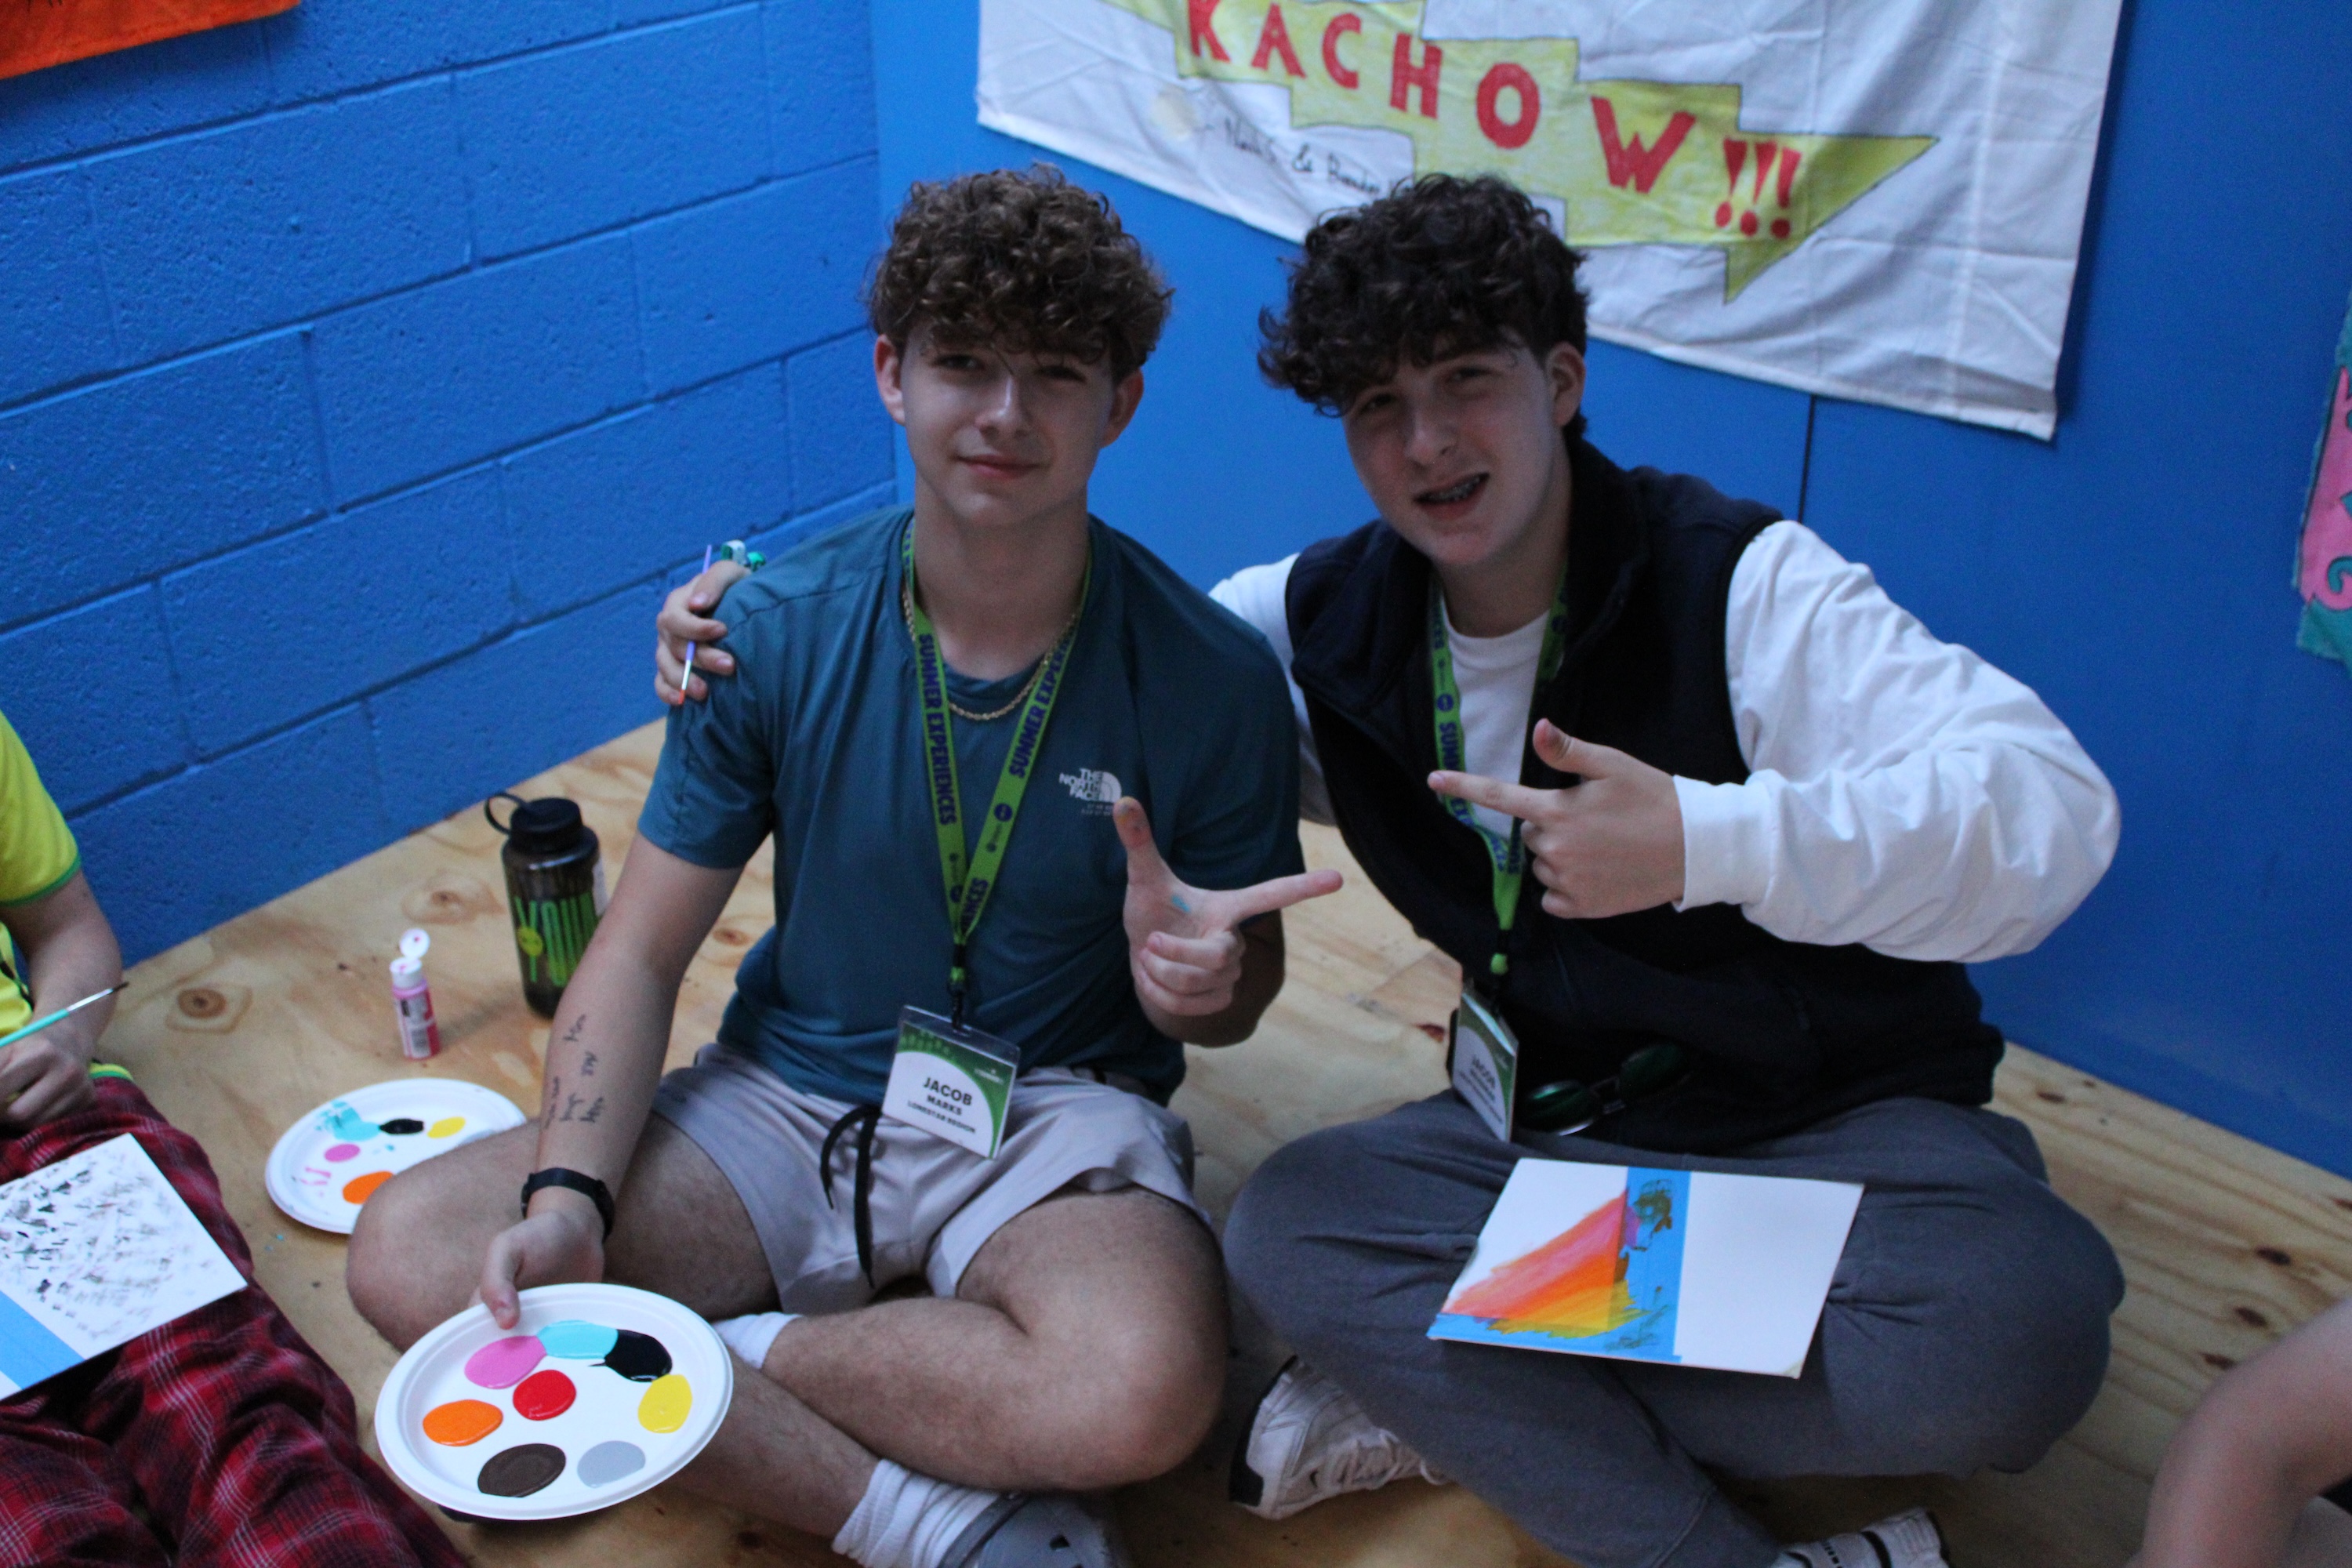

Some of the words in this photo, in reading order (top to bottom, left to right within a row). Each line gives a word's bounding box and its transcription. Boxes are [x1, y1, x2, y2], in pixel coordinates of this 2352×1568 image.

[919, 633, 944, 709] SUMMER
[926, 712, 957, 826] EXPERIENCES
[1008, 705, 1047, 778] SUMMER
[924, 1076, 972, 1105] JACOB
[927, 1094, 963, 1116] MARKS
